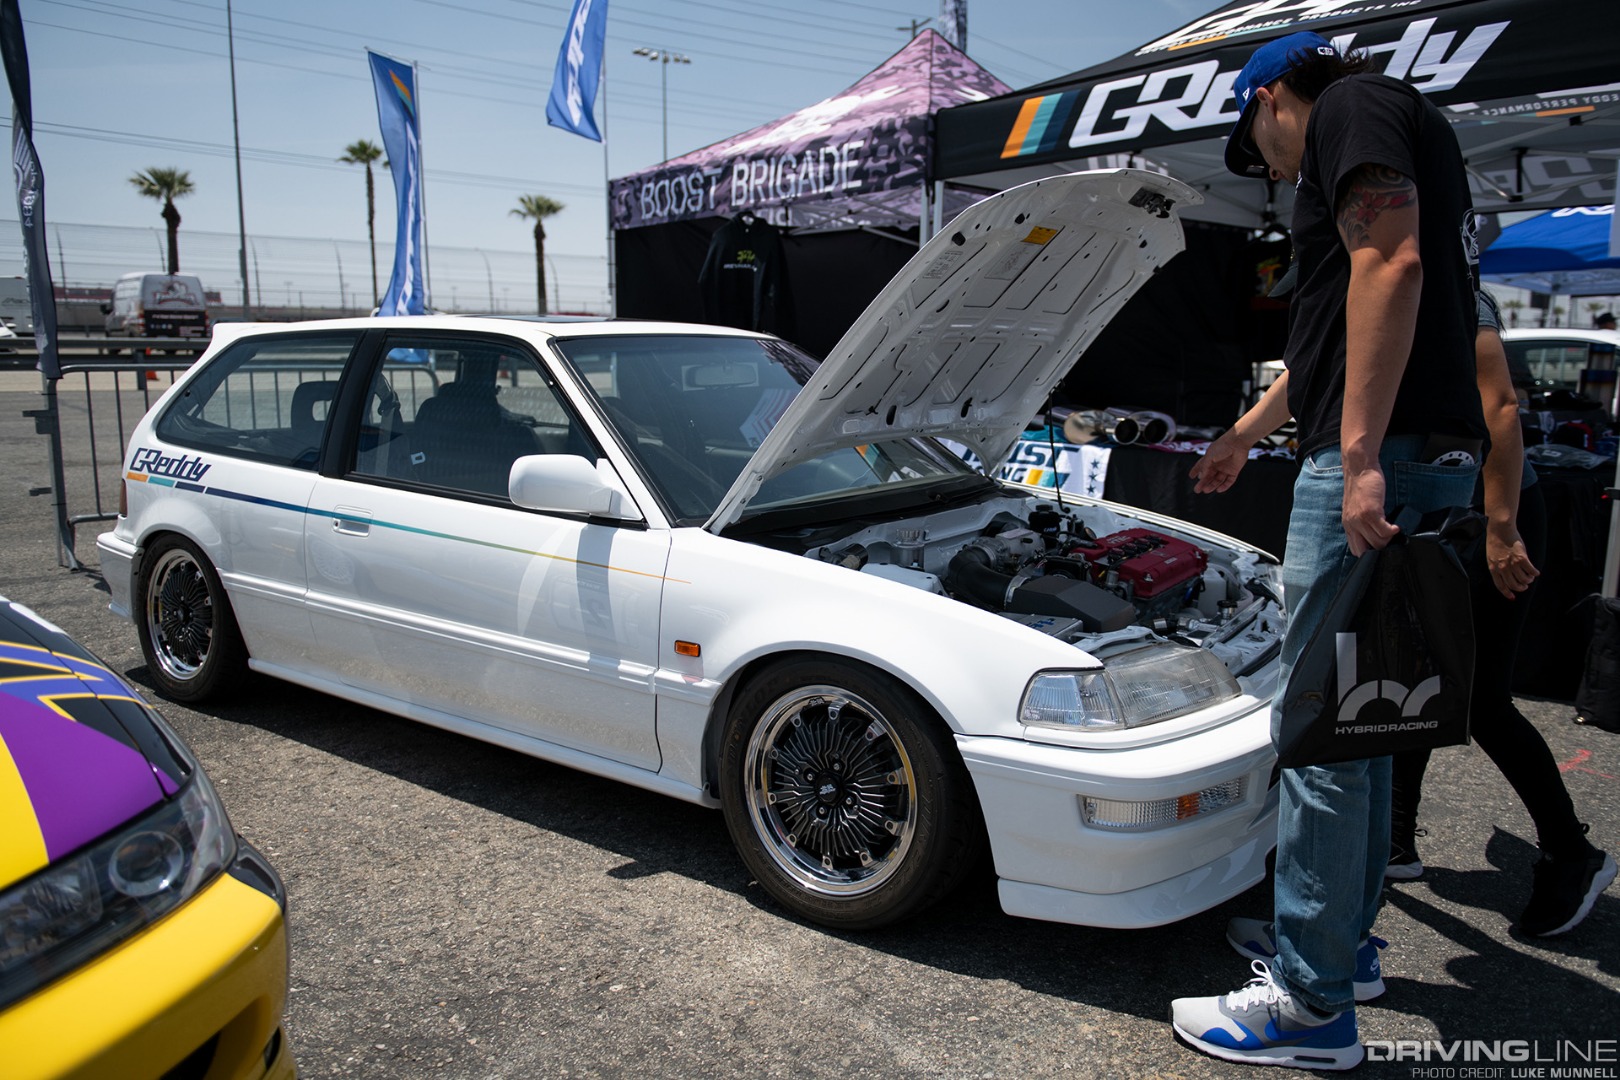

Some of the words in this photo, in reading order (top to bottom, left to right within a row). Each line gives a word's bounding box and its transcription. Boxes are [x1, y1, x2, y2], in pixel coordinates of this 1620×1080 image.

[1299, 4, 1386, 22] PRODUCTS
[1068, 17, 1511, 148] GRedy
[640, 167, 722, 220] BOOST
[731, 140, 865, 207] BRIGADE
[129, 447, 212, 482] GReddy
